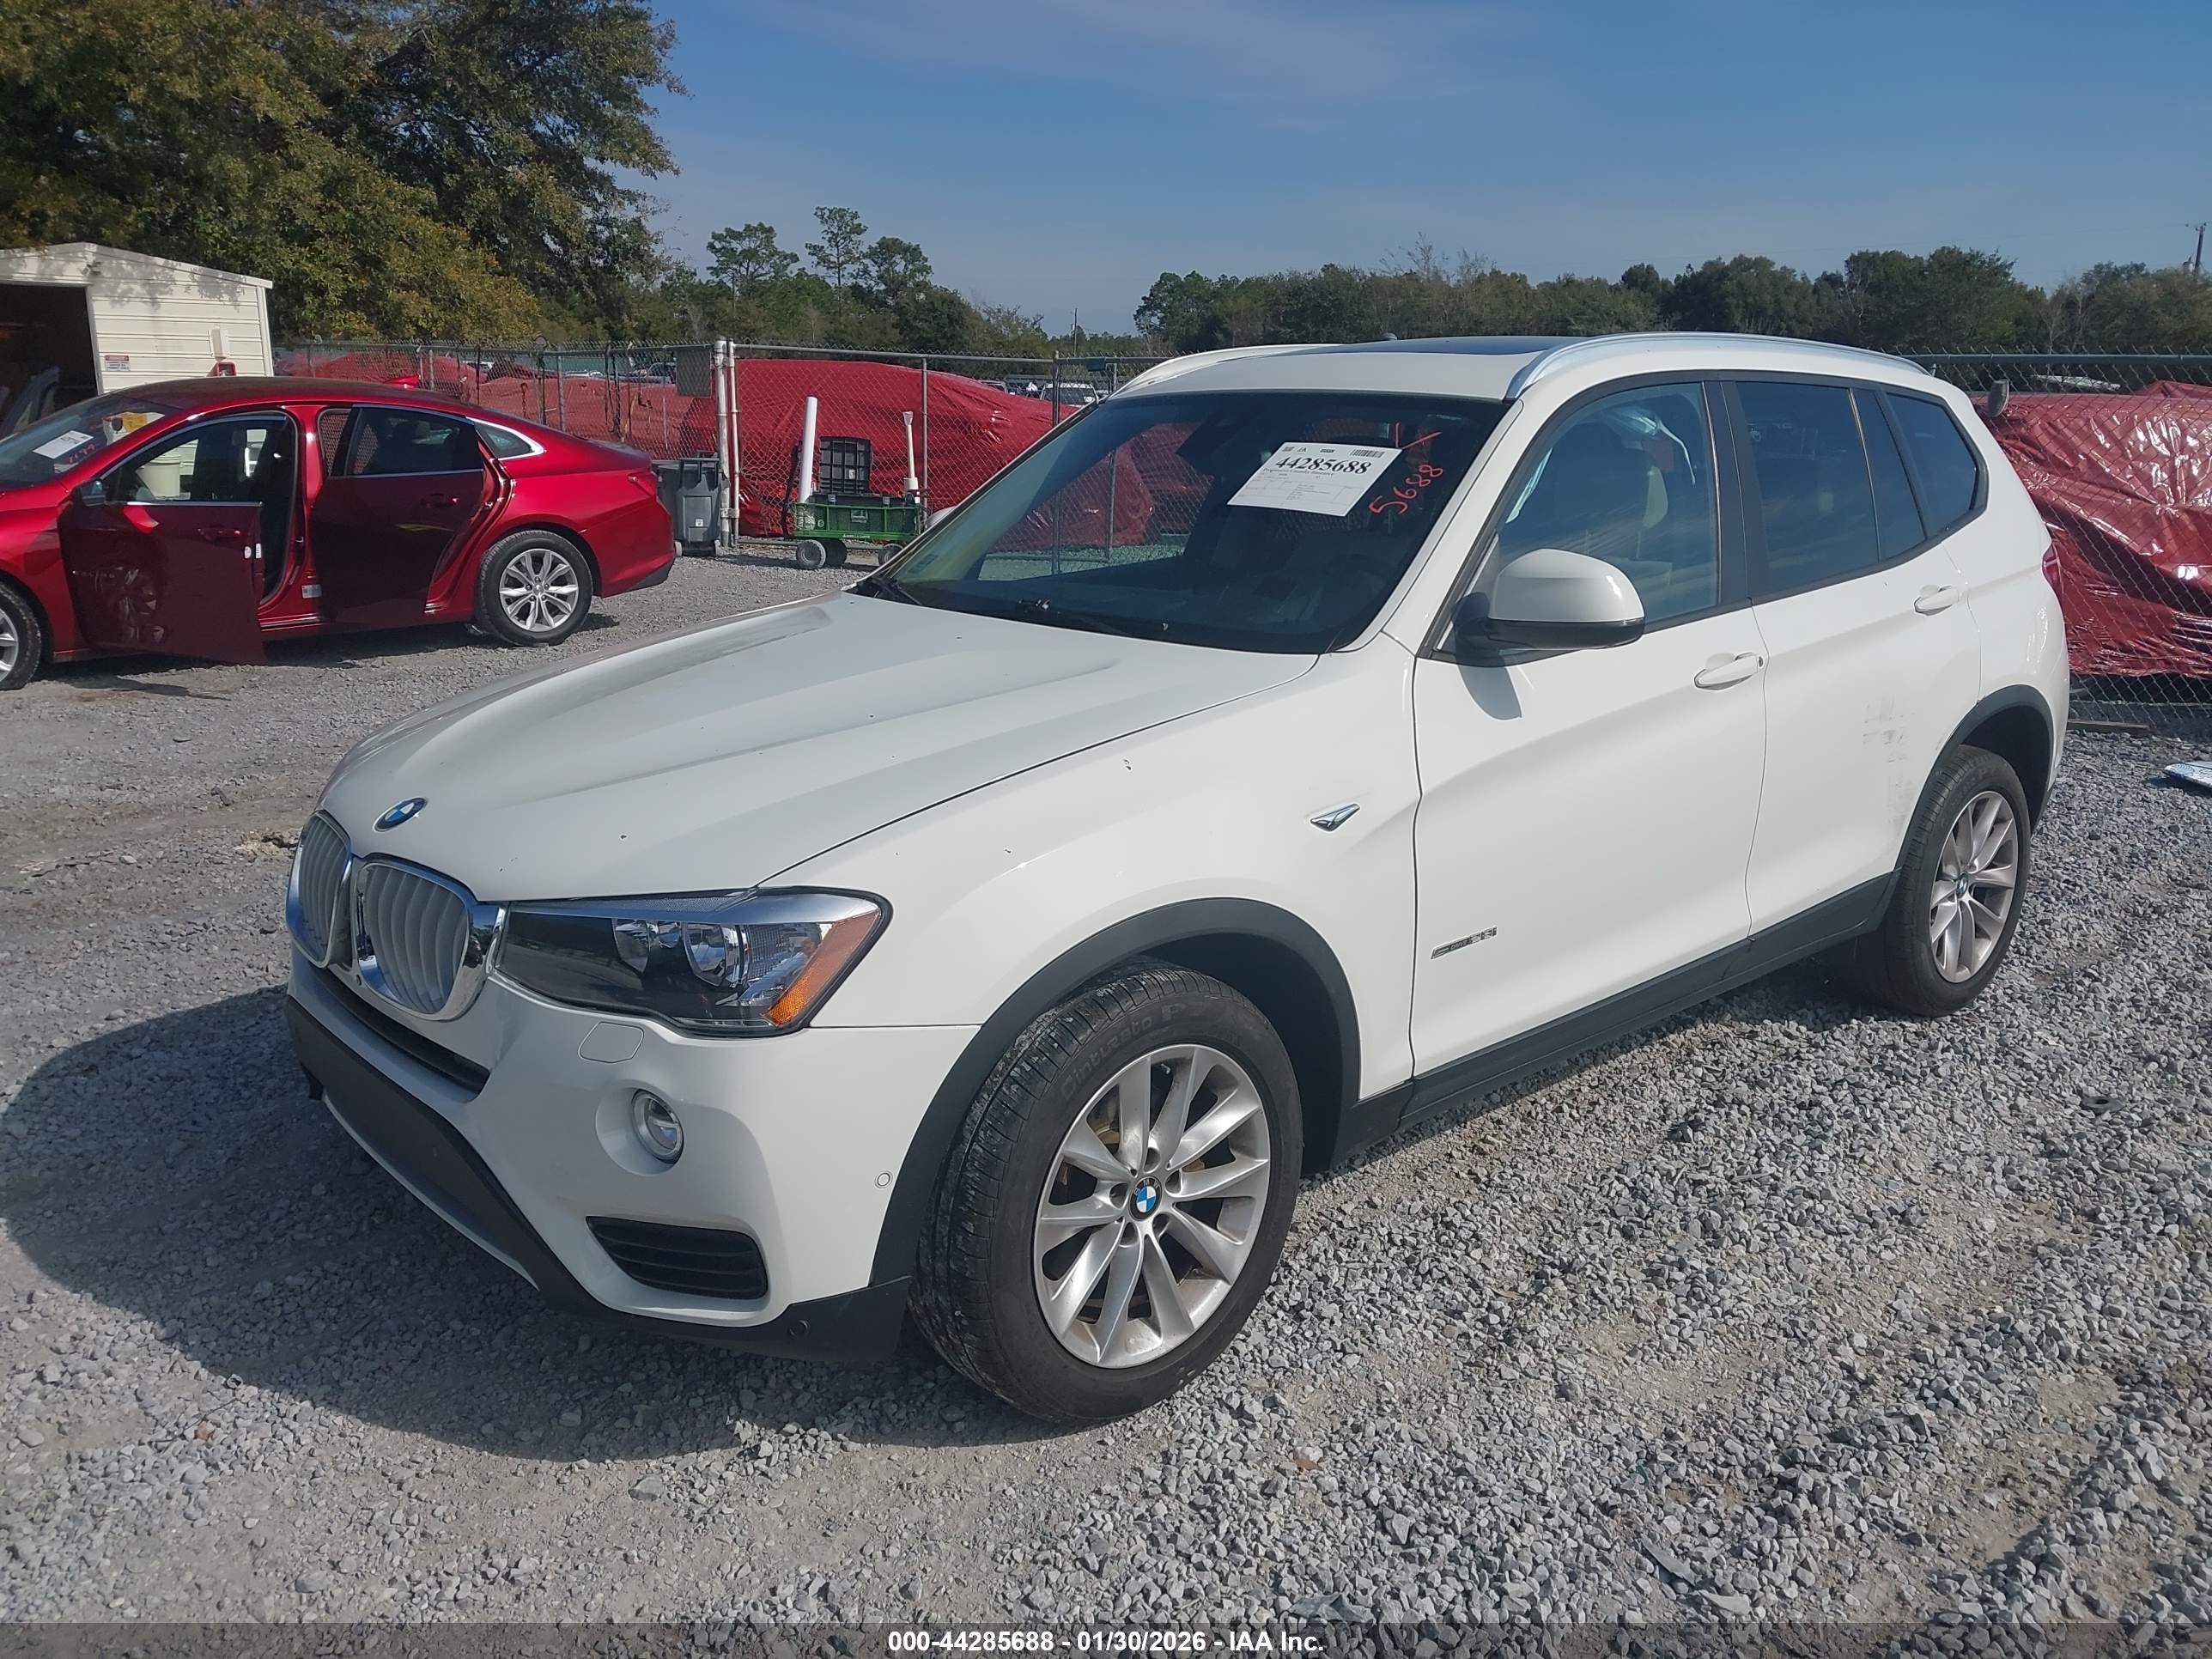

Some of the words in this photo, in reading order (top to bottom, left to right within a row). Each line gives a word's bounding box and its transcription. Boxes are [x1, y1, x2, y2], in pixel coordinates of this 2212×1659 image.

[1275, 457, 1372, 475] 44285688
[1368, 465, 1443, 514] 5688
[1060, 1017, 1154, 1101] Cinturato
[1133, 1178, 1160, 1196] BMW
